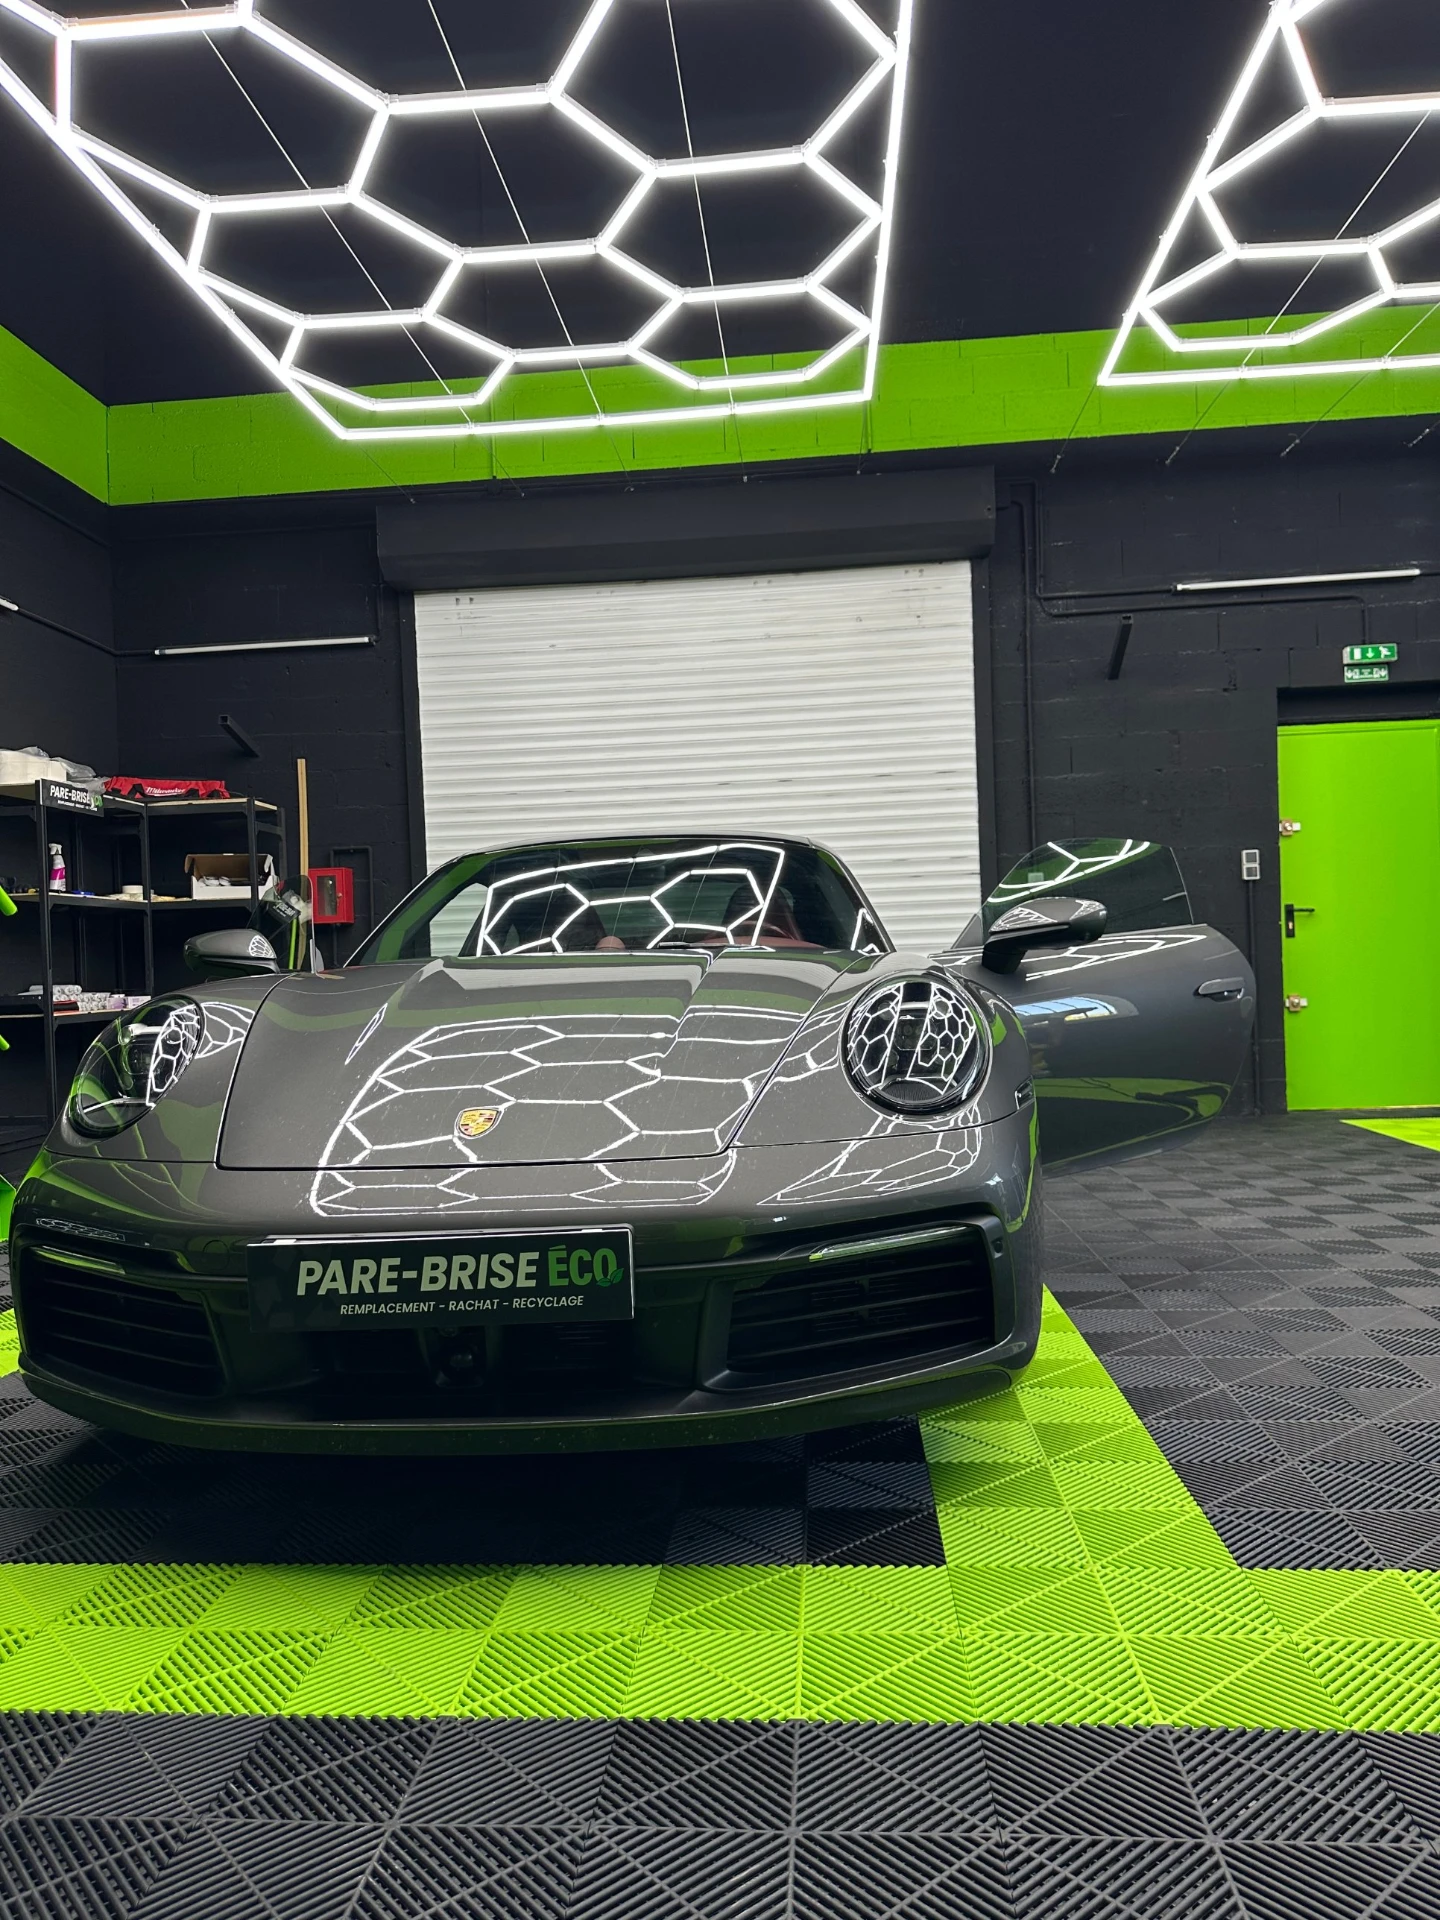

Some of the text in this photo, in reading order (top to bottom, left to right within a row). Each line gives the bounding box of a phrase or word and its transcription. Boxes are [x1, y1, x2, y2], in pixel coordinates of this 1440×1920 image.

[296, 1244, 618, 1296] PARE-BRISE ÉCO
[340, 1300, 436, 1315] REMPLACEMENT
[448, 1298, 498, 1312] RACHAT
[512, 1295, 584, 1309] RECYCLAGE
